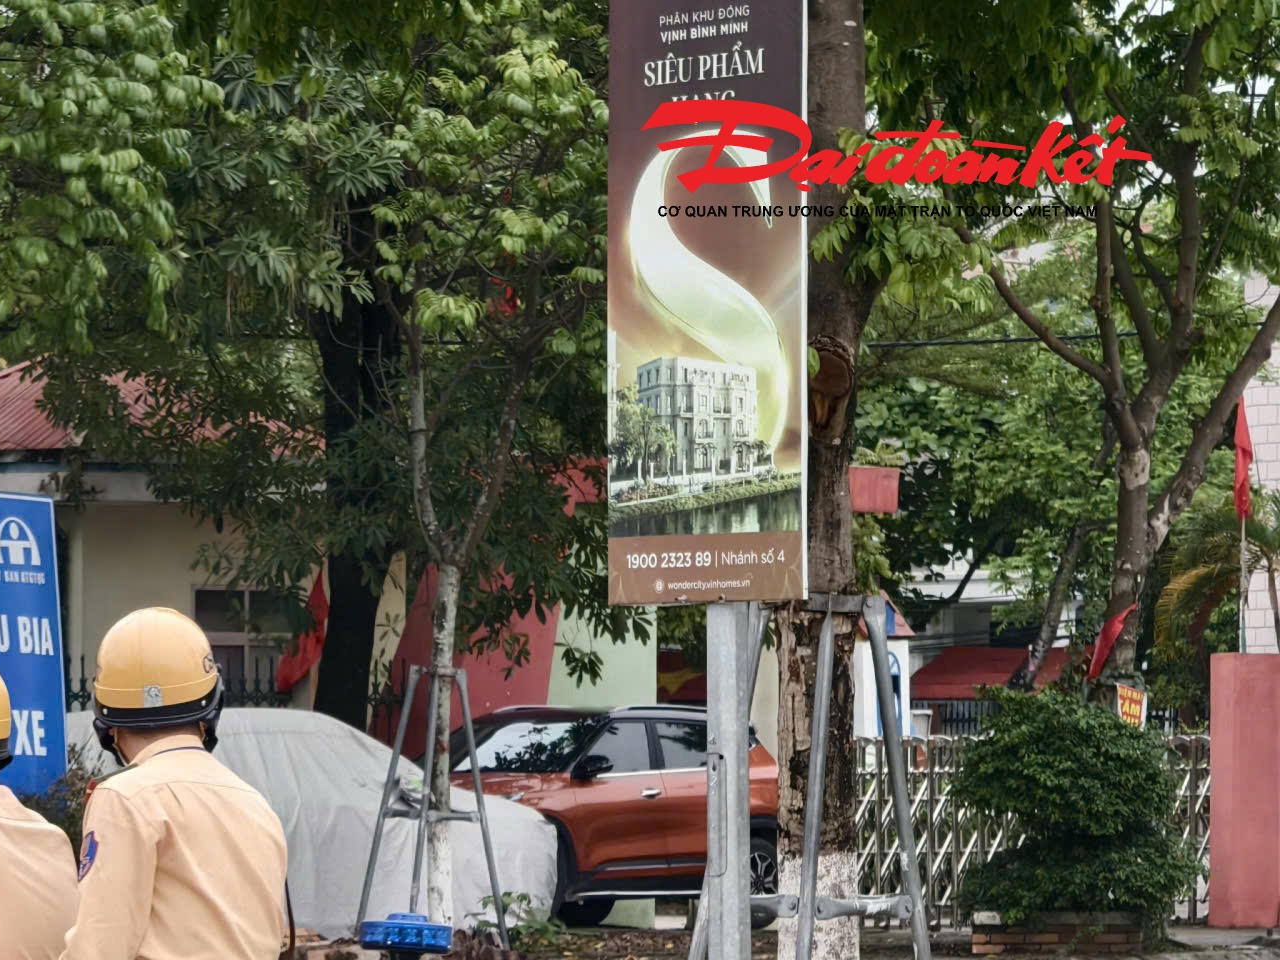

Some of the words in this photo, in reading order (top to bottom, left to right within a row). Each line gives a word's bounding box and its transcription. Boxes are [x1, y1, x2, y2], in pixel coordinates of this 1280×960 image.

[659, 12, 689, 27] PHÂN
[692, 9, 715, 23] KHU
[718, 4, 750, 20] ĐÔNG
[660, 28, 687, 45] VỊNH
[690, 24, 717, 39] BÌNH
[720, 20, 749, 36] MINH
[643, 52, 694, 87] SIÊU
[697, 40, 765, 81] PHẨM
[626, 552, 657, 569] 1900
[661, 551, 692, 568] 2323
[695, 551, 712, 567] 89
[721, 550, 758, 566] Nhánh
[760, 547, 775, 564] số
[777, 549, 785, 563] 4
[667, 579, 751, 591] wondercity.vinhomes.vn
[17, 615, 55, 656] BIA
[13, 709, 47, 756] XE
